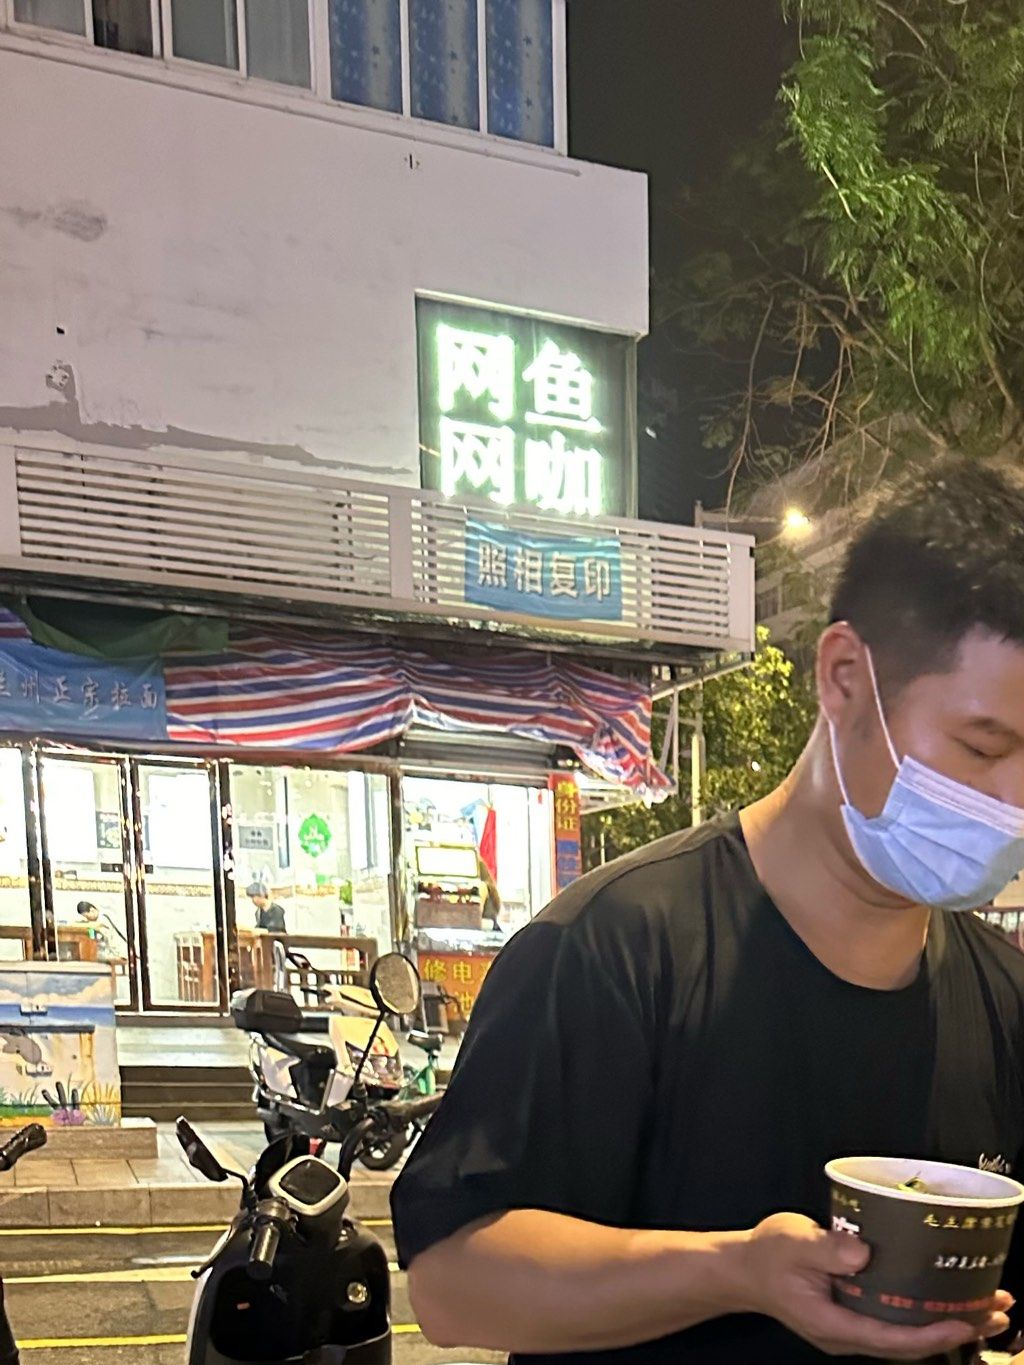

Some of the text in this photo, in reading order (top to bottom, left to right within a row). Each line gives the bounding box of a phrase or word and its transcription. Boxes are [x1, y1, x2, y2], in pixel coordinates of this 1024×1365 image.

[436, 322, 603, 433] 网鱼
[438, 415, 603, 516] 网咖
[478, 540, 613, 601] 照相复印
